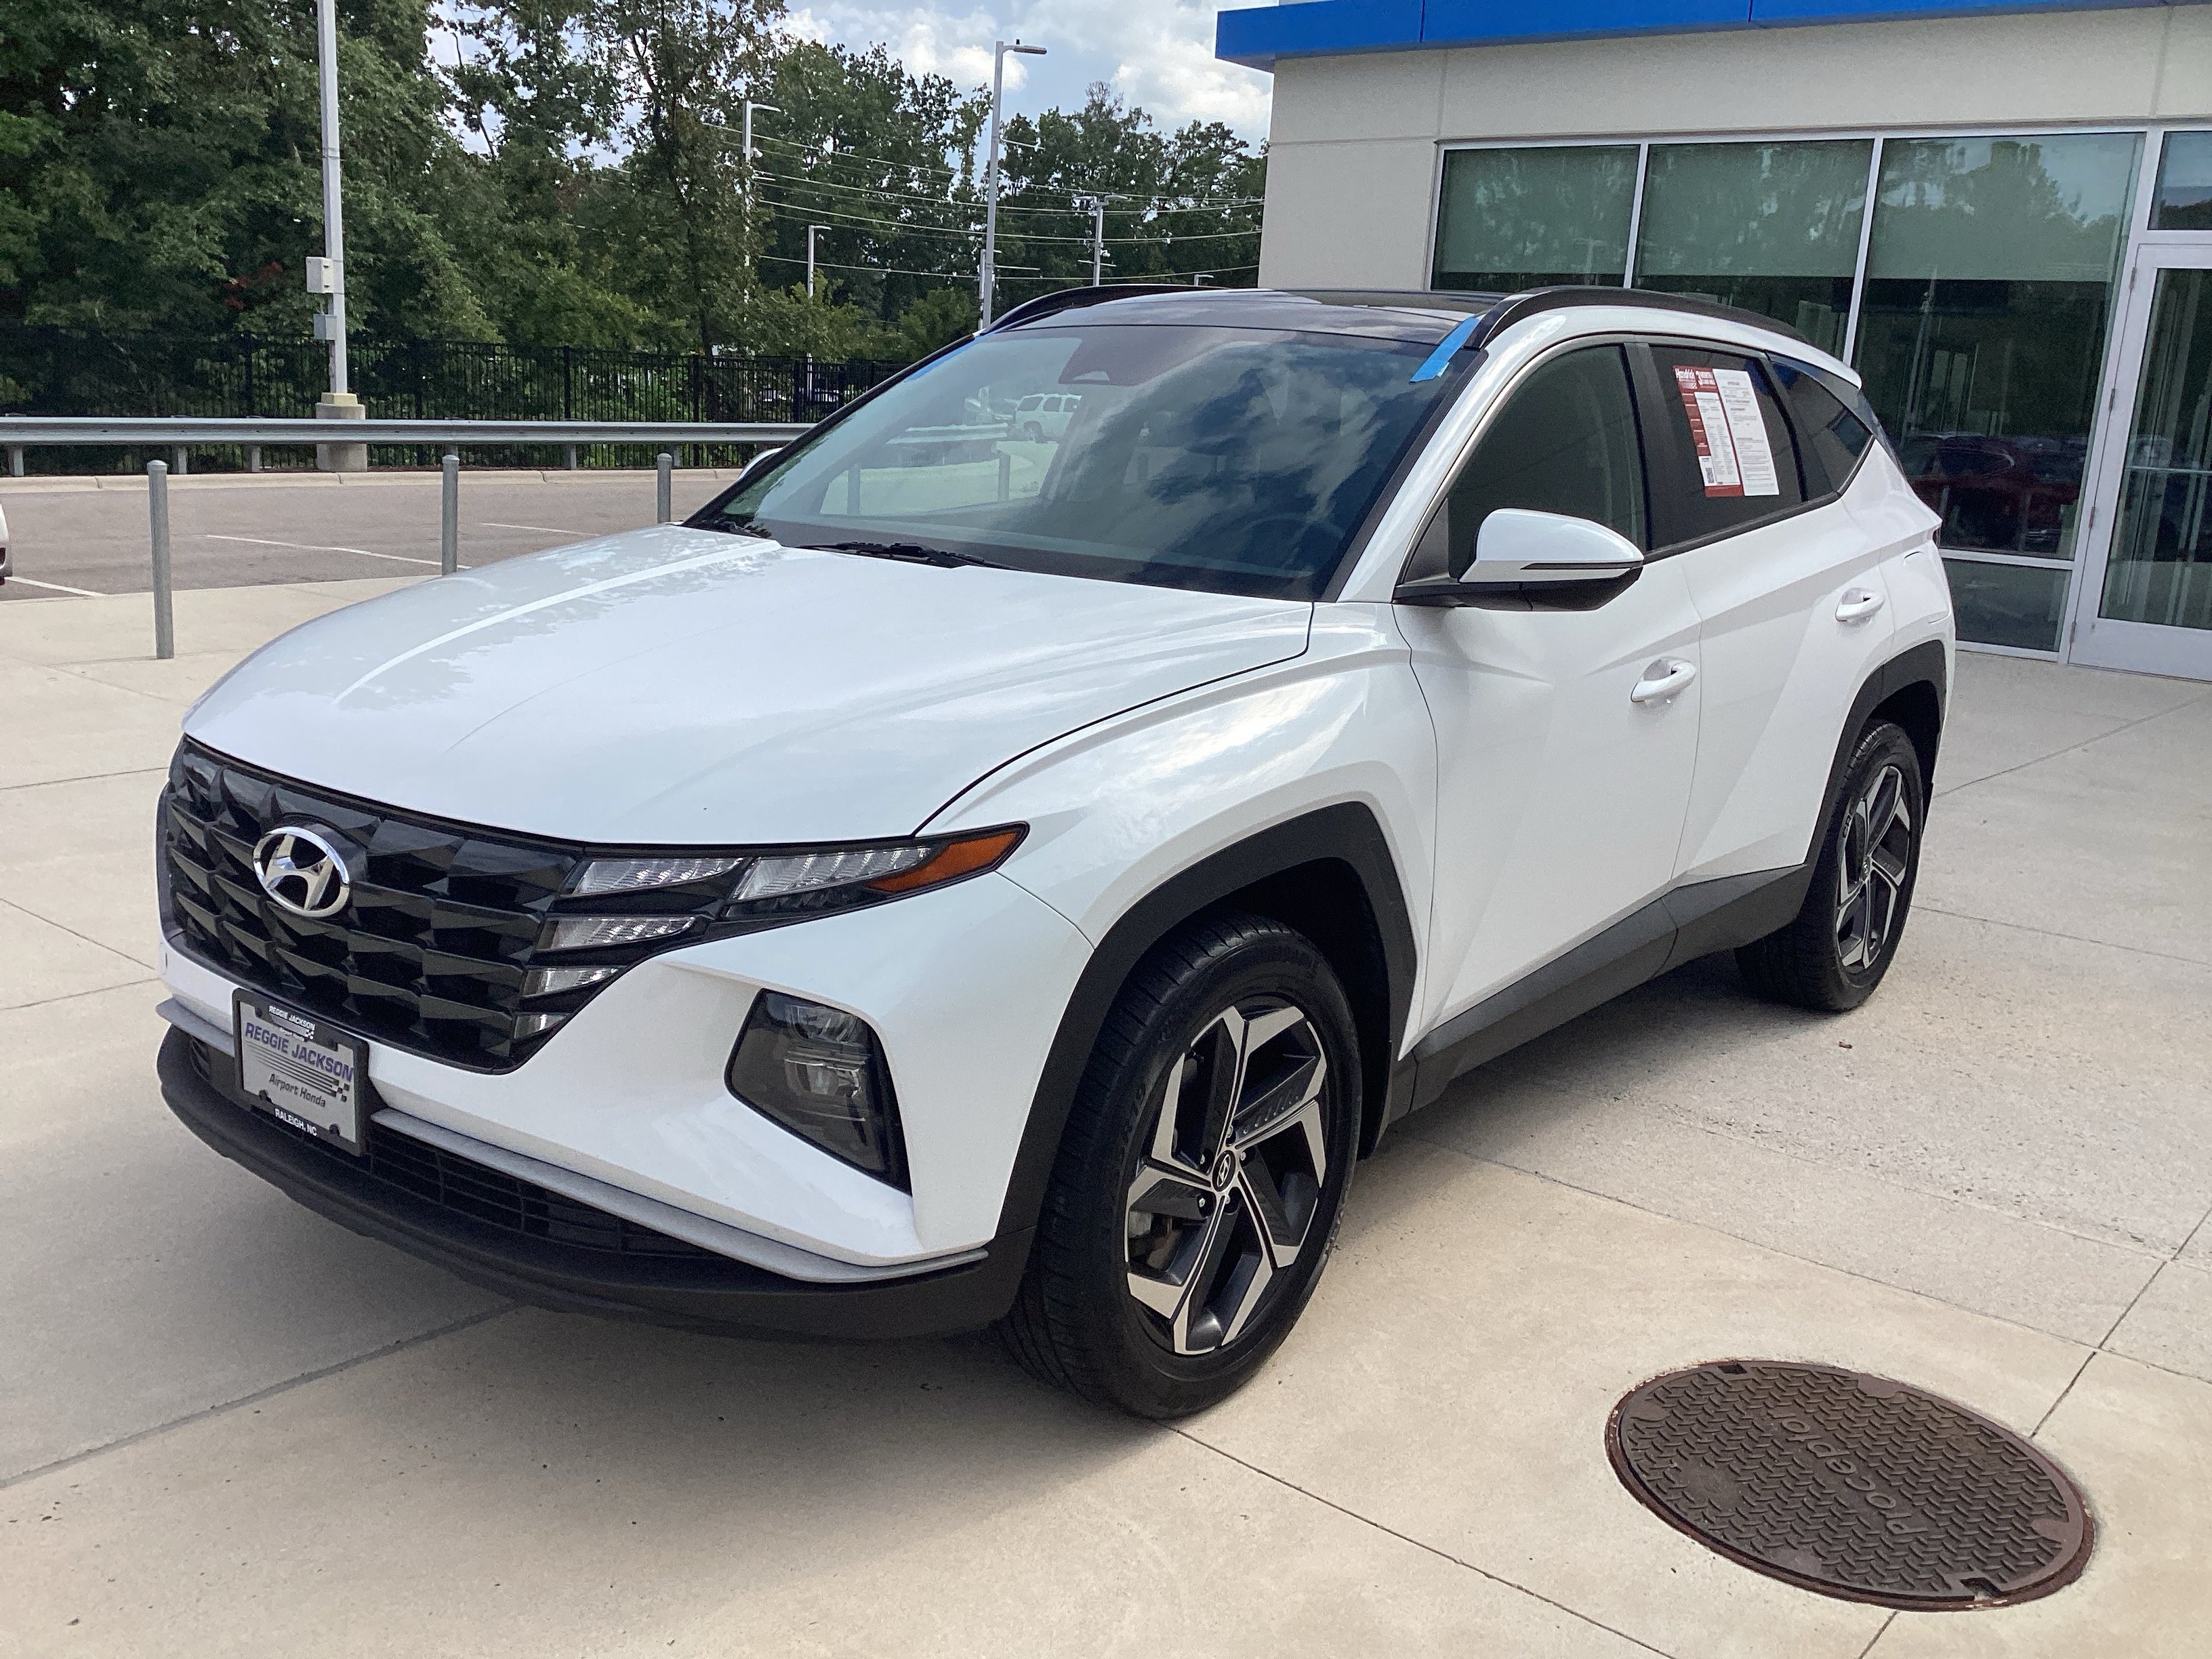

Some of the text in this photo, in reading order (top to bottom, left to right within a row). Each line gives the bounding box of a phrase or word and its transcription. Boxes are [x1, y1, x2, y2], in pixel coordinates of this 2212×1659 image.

[269, 1005, 315, 1031] REGGIE JACKSON
[245, 1023, 354, 1082] REGGIE JACKSON
[269, 1073, 326, 1107] Airport Honda
[274, 1108, 317, 1136] RALEIGH, NC
